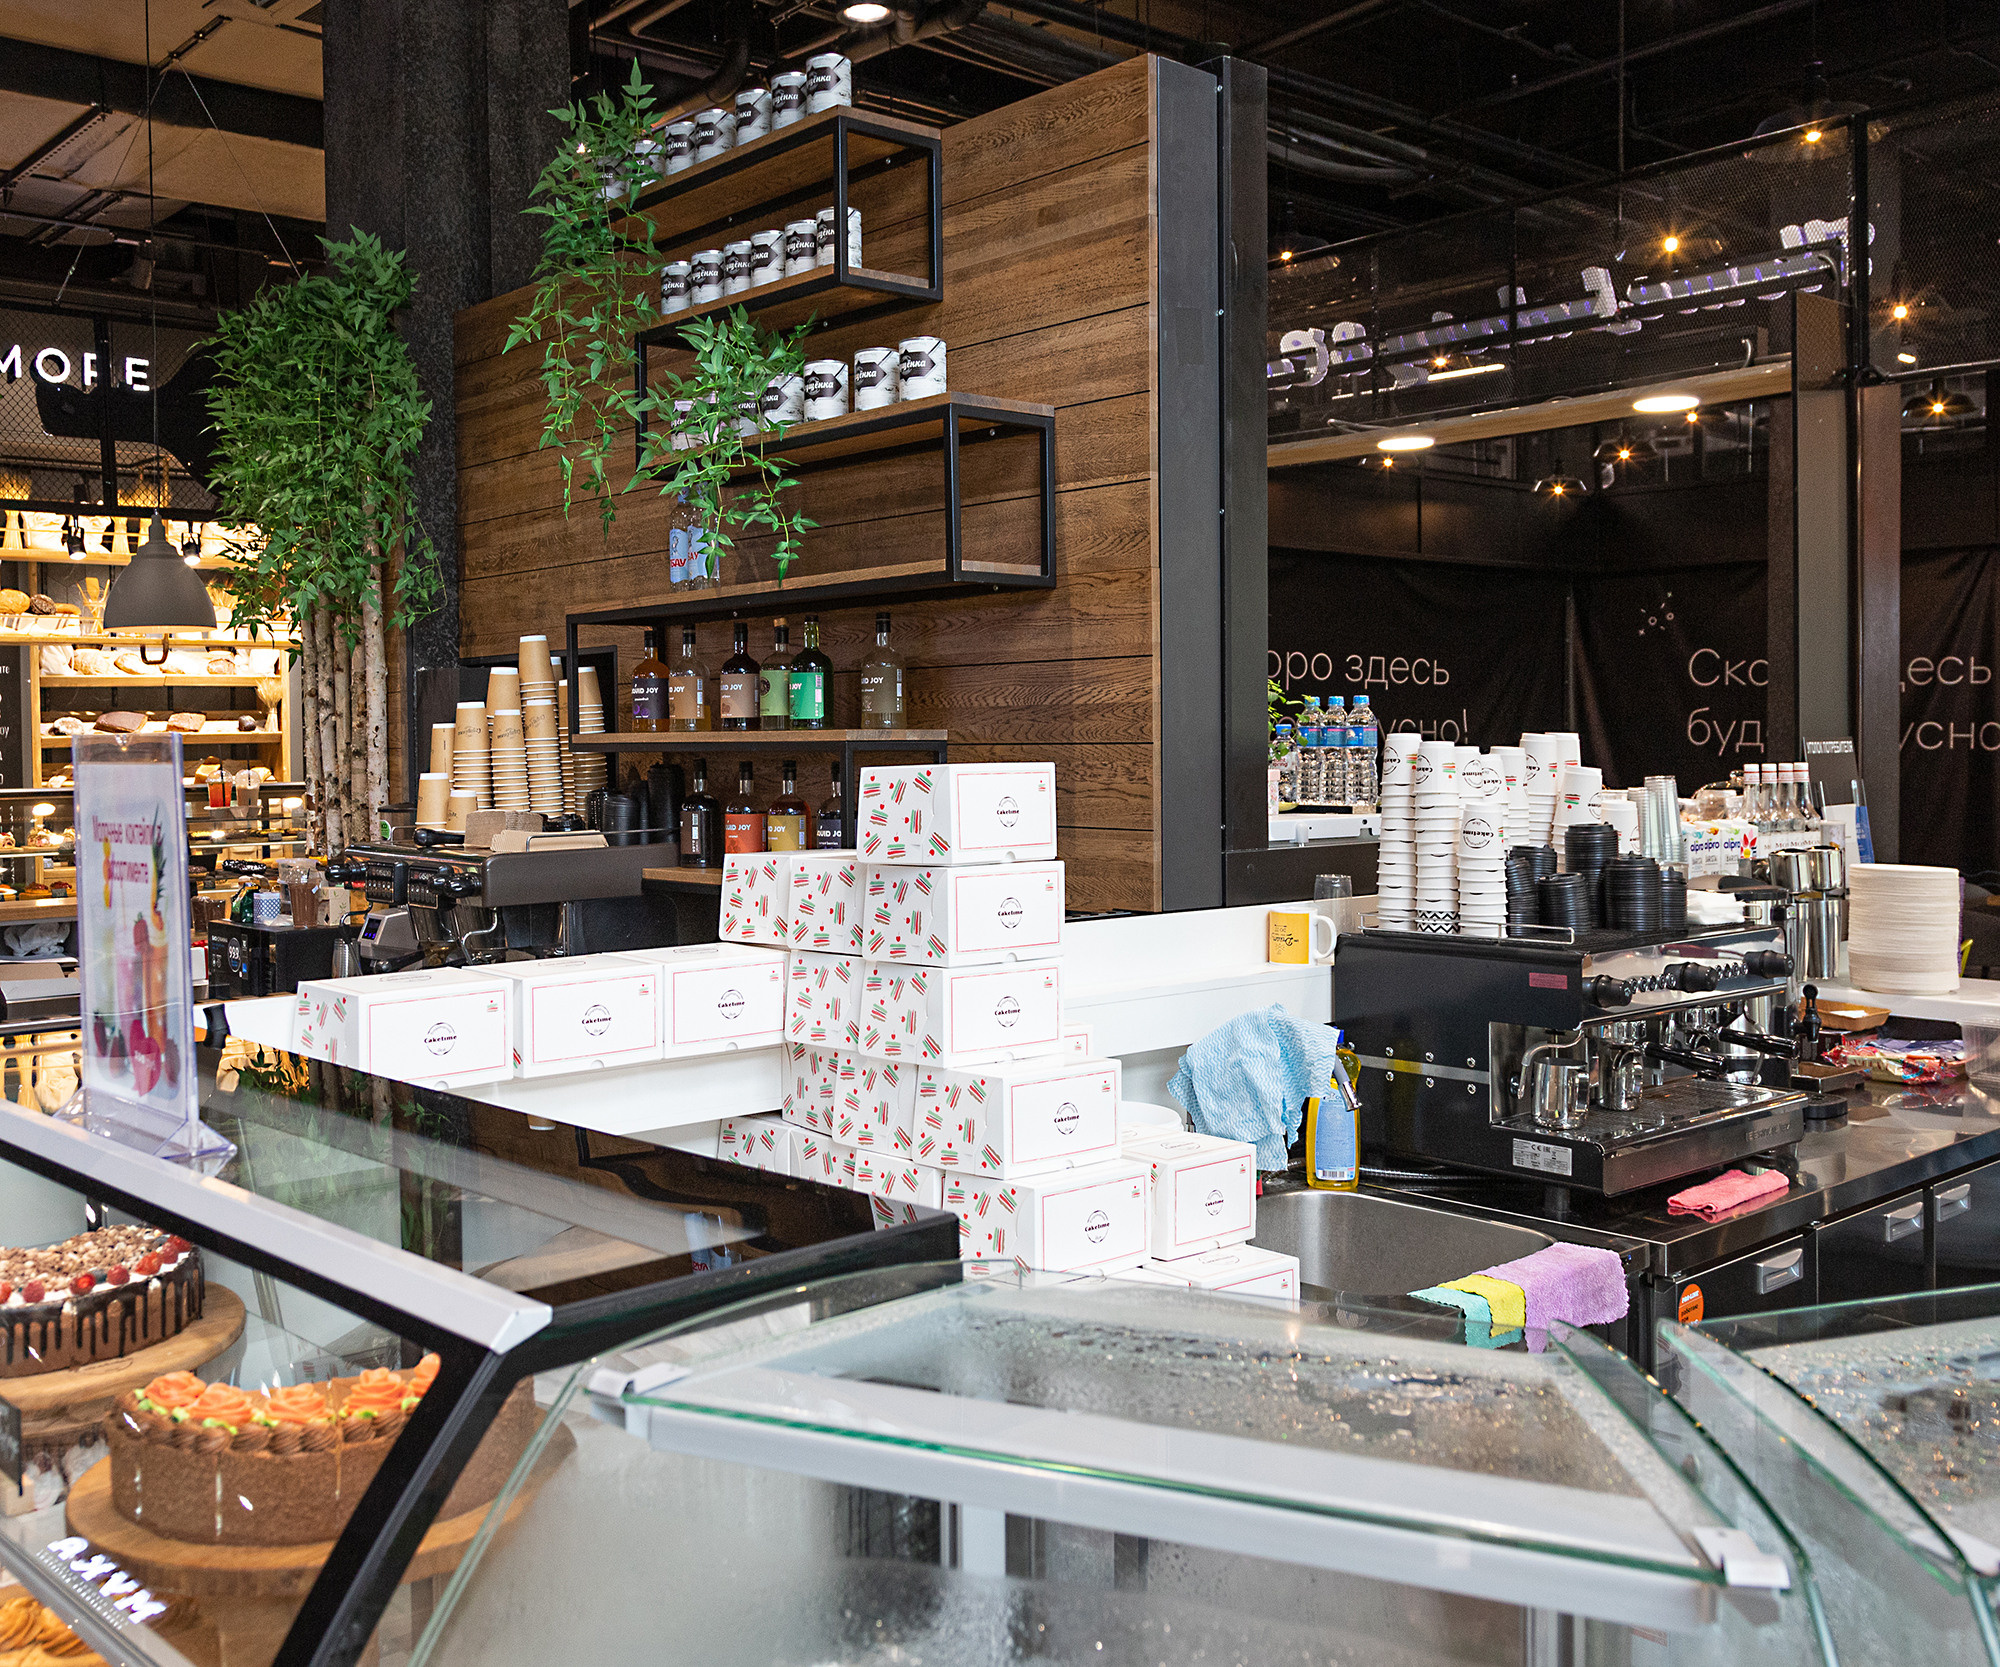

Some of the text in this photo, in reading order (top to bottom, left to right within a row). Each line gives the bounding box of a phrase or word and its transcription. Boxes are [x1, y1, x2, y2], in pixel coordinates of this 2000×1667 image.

[1345, 654, 1450, 691] здесь
[1900, 655, 1993, 693] есь
[997, 909, 1024, 917] Caketime
[717, 1000, 745, 1009] Caketime
[994, 1008, 1021, 1016] Caketime
[581, 1016, 612, 1025] Caketime
[423, 1034, 457, 1044] Caketime
[1053, 1113, 1080, 1124] Caketime
[1084, 1221, 1111, 1232] Caketime
